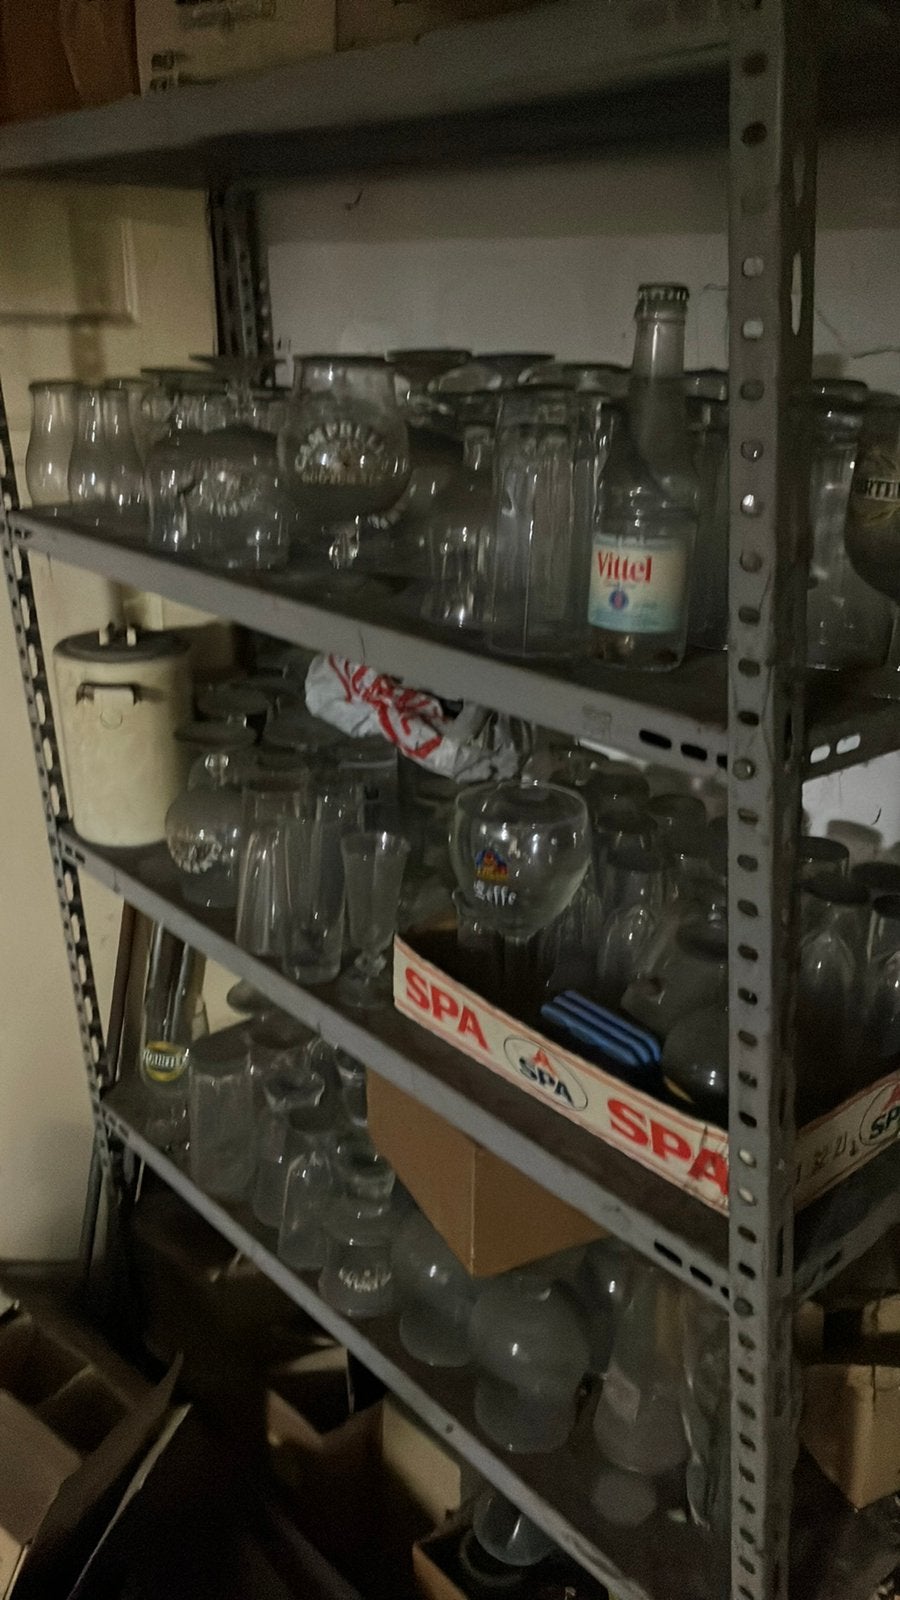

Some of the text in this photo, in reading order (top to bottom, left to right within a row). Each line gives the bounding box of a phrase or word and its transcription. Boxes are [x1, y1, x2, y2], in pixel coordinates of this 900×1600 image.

[598, 550, 652, 583] Vittel
[405, 967, 489, 1051] SPA
[519, 1057, 574, 1107] SPA
[607, 1098, 729, 1197] SPA
